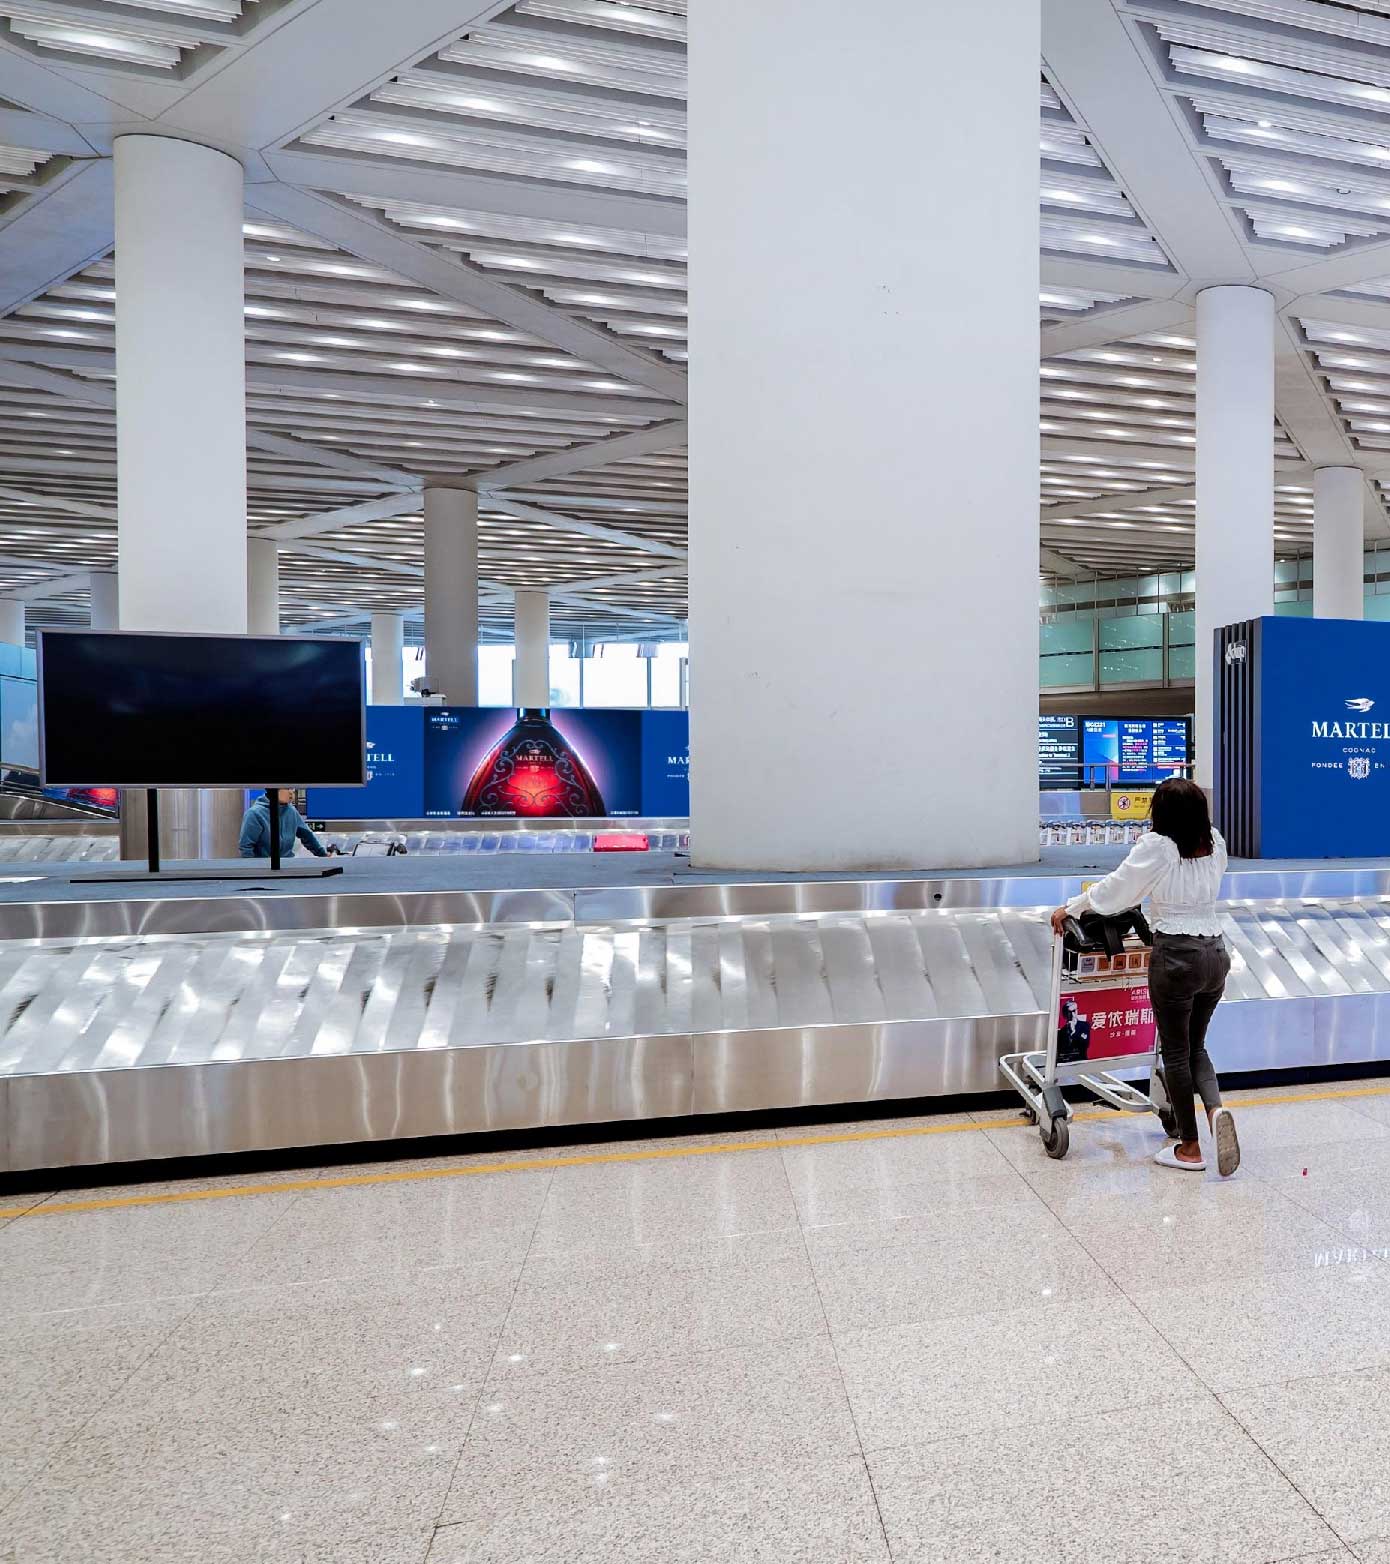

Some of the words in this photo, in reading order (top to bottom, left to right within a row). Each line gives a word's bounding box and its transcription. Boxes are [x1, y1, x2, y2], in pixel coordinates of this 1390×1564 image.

[1065, 716, 1075, 728] B
[366, 753, 395, 762] TELL
[1091, 1008, 1154, 1030] 爱依瑞斯
